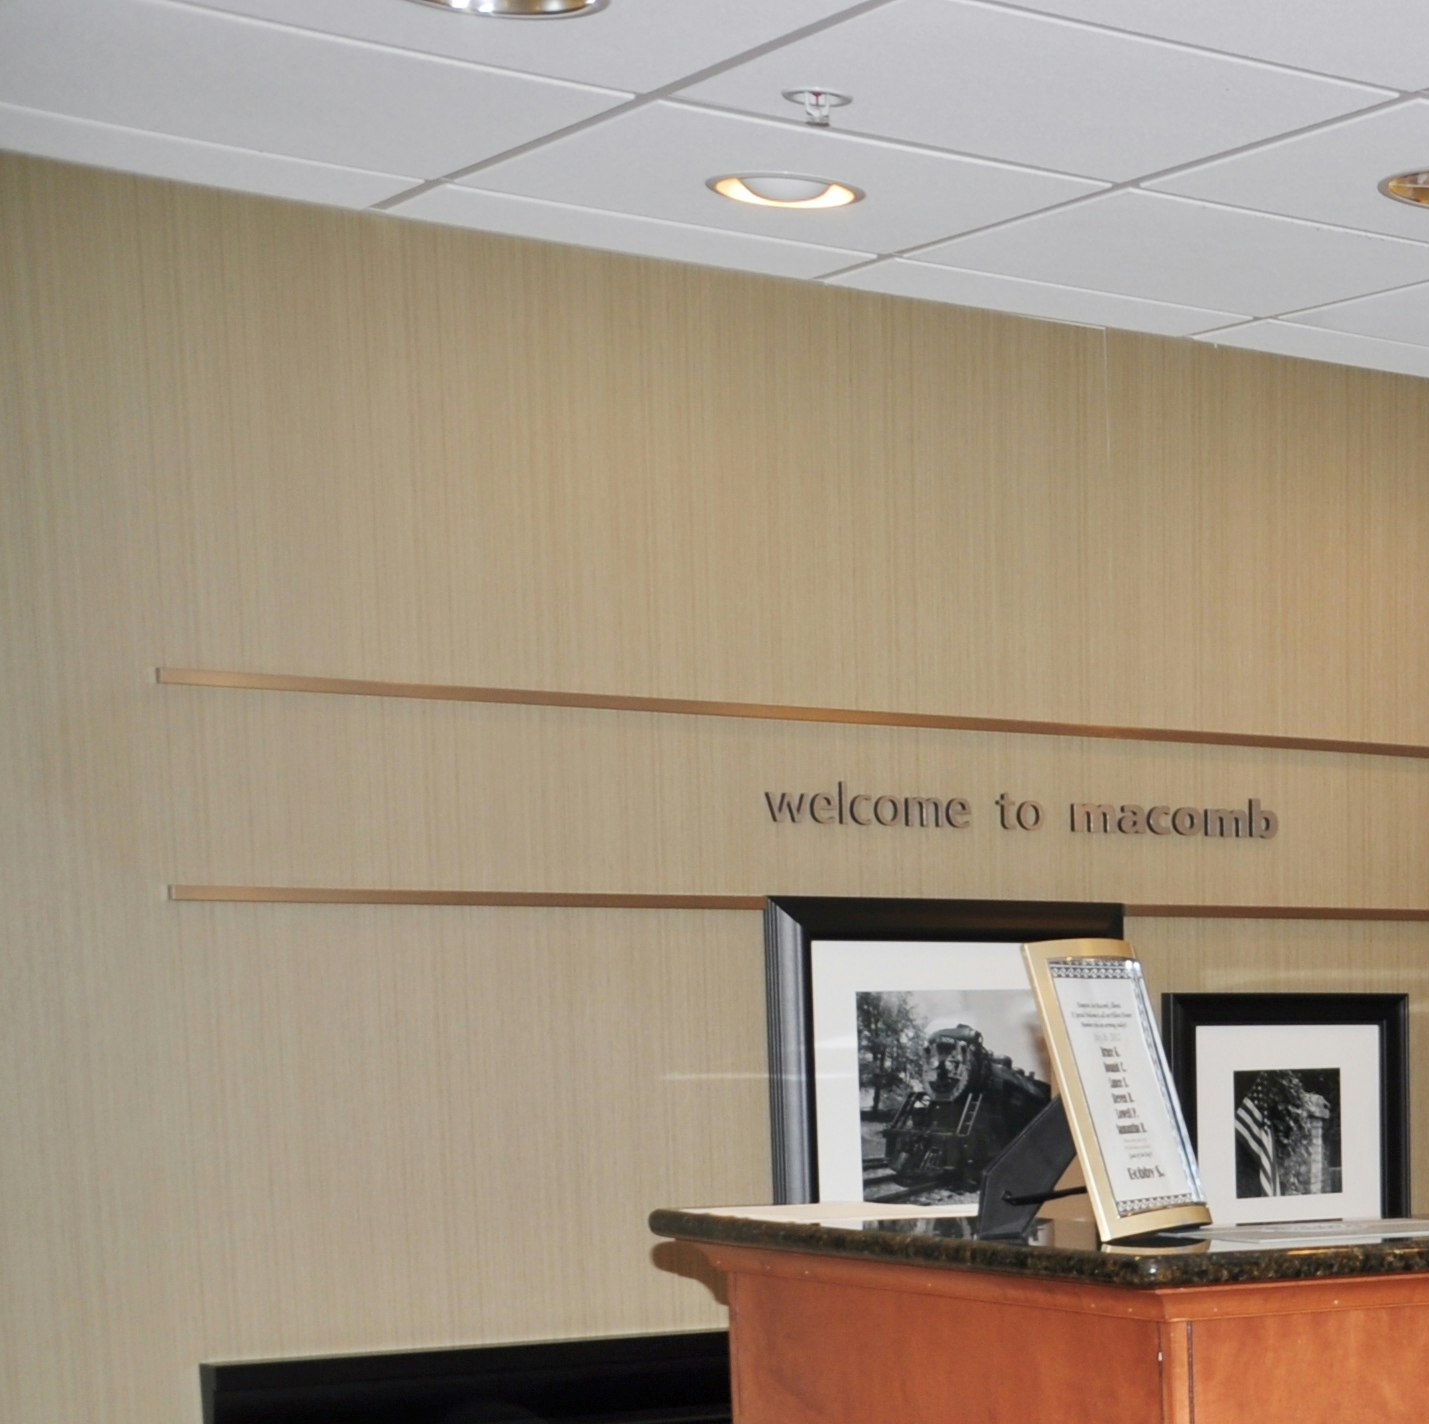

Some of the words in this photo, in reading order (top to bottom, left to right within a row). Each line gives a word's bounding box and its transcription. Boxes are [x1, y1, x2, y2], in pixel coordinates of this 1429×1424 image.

[763, 781, 972, 830] welcome
[995, 792, 1045, 832] to
[1068, 797, 1280, 841] macomb
